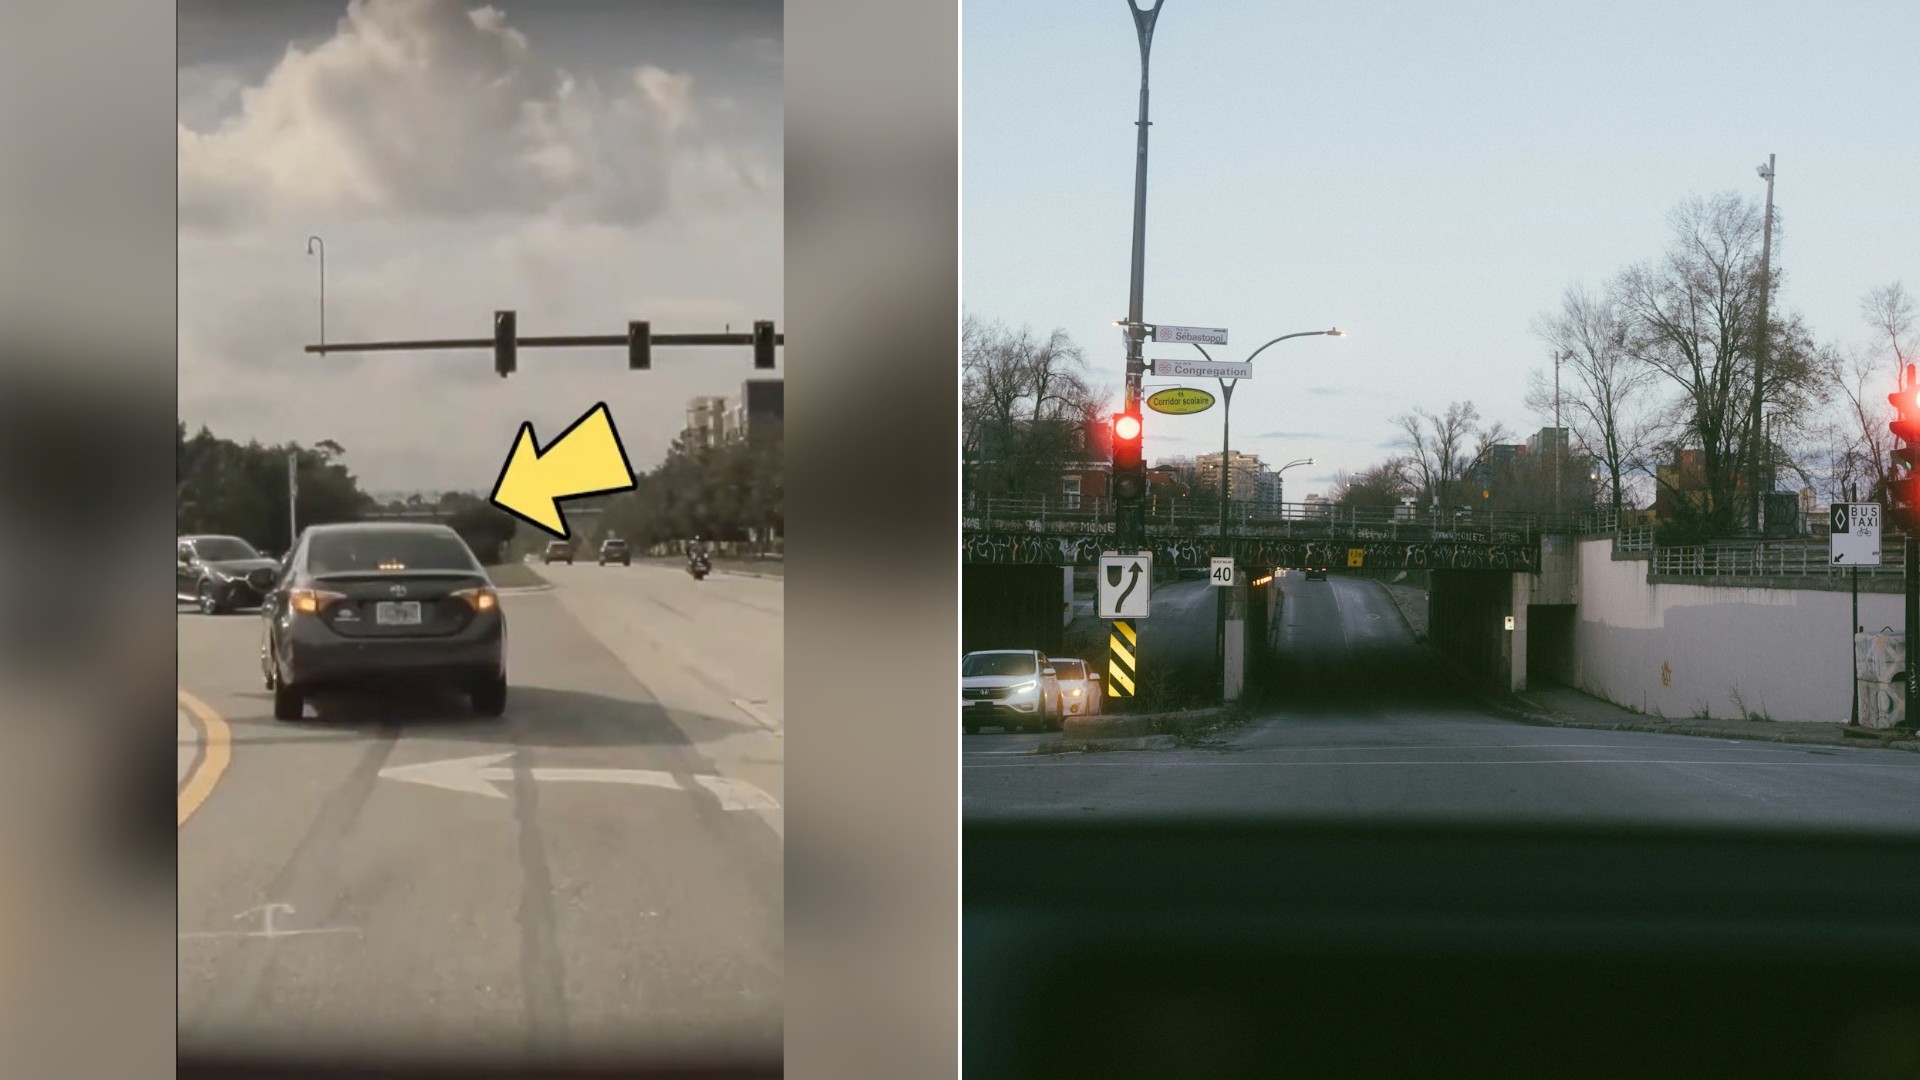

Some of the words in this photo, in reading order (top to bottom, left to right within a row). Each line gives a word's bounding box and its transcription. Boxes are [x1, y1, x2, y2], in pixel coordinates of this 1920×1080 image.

[1175, 331, 1223, 343] Sébastopol
[1174, 365, 1247, 376] Congregation
[1153, 397, 1181, 406] Corridor
[1182, 396, 1209, 405] scolaire
[1851, 507, 1878, 517] BUS
[1851, 517, 1878, 527] TAXI
[1212, 567, 1231, 581] 40
